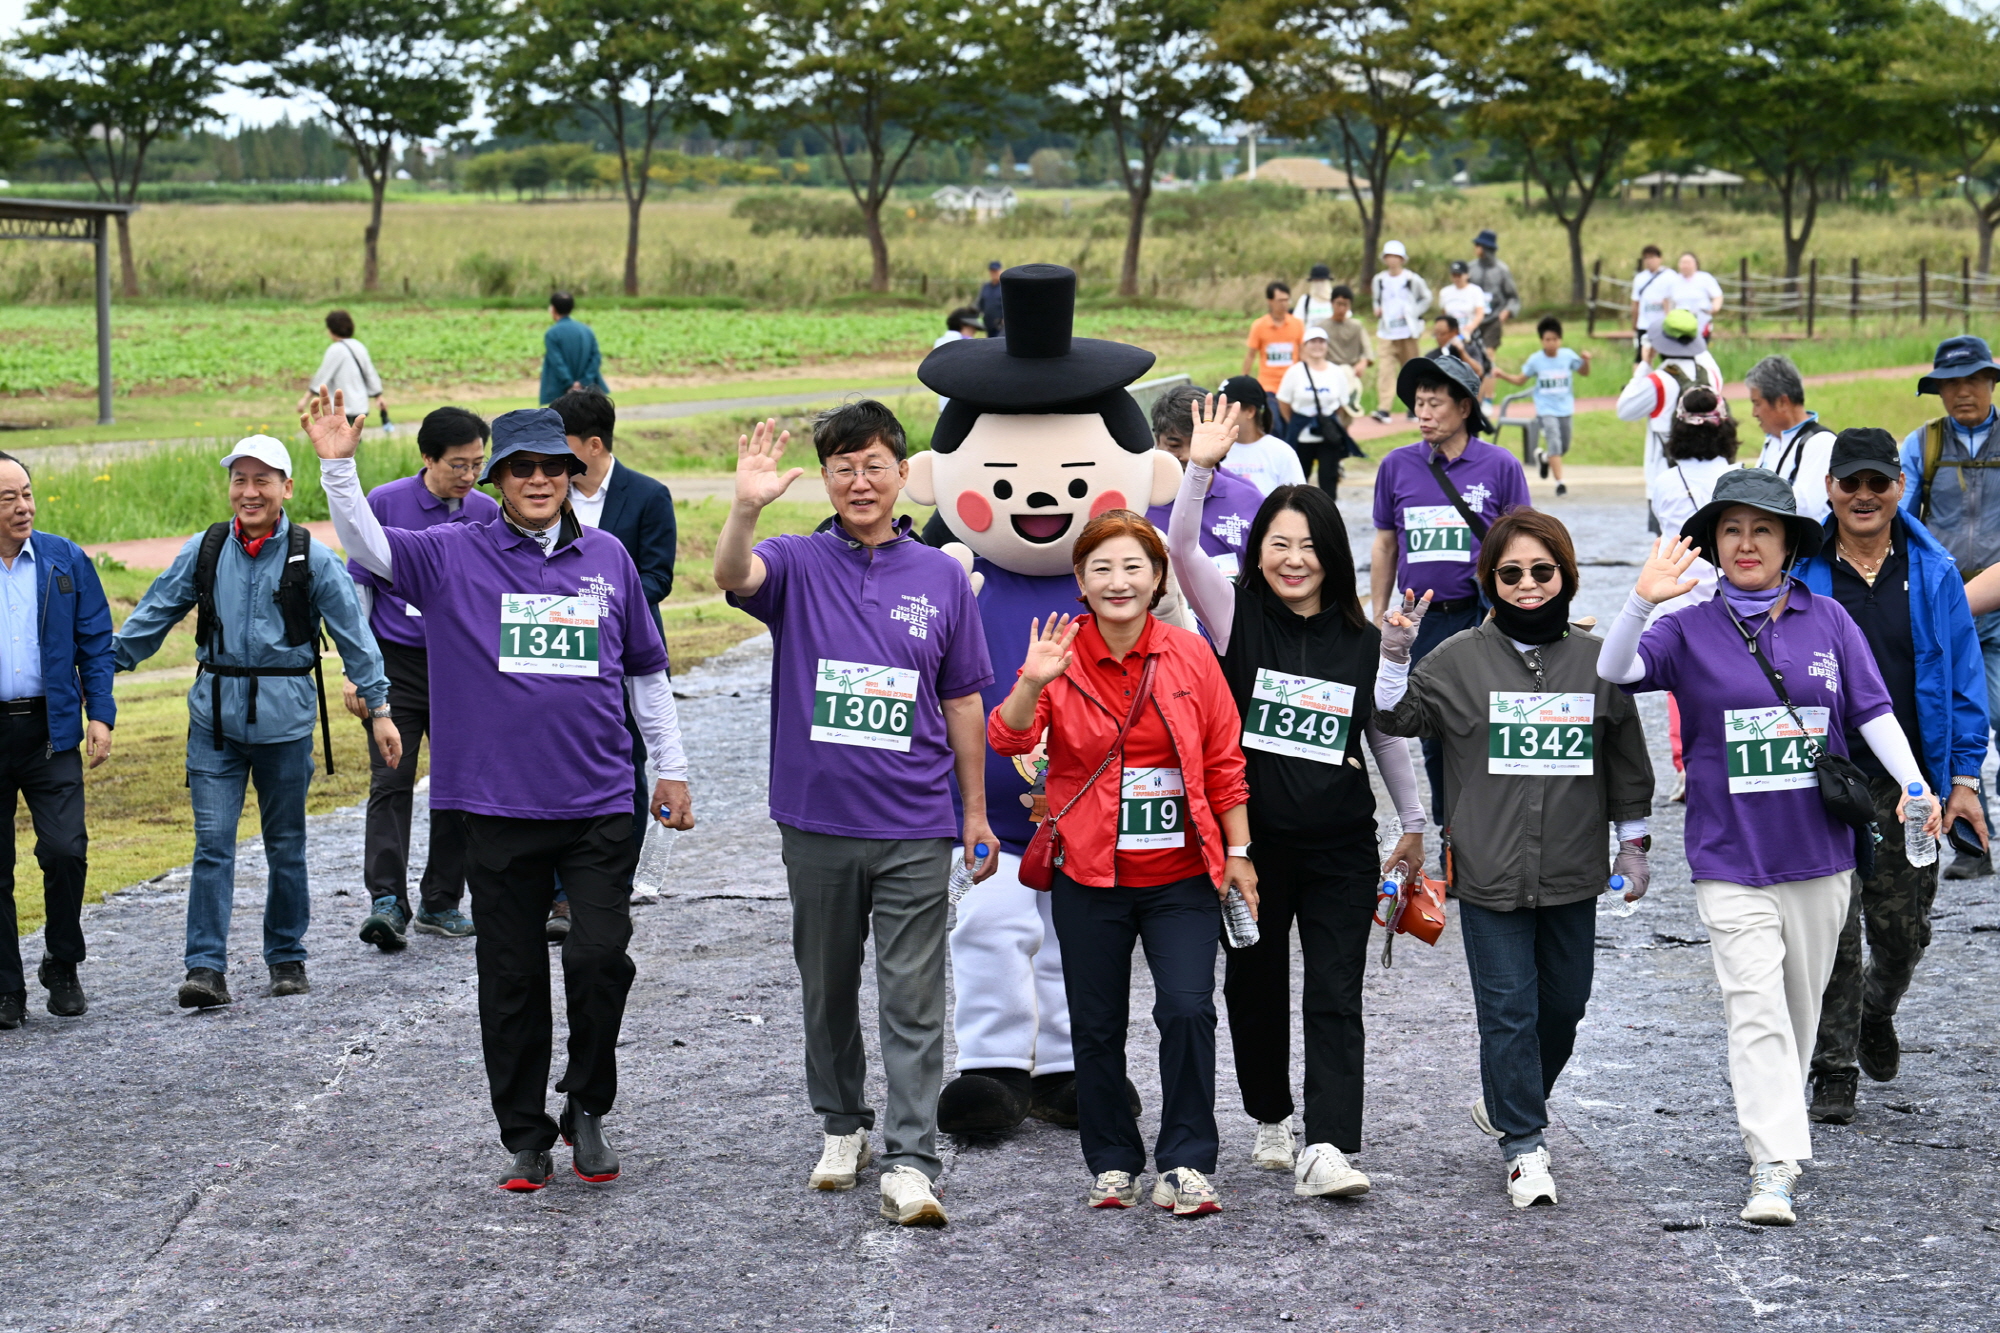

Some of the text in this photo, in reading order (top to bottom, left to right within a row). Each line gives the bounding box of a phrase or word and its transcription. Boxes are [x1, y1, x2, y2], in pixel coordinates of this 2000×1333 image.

[1410, 528, 1463, 551] 0711
[890, 608, 928, 629] 대부포도
[910, 602, 928, 617] 안산
[509, 626, 585, 657] 1341
[908, 625, 928, 640] 축제
[825, 695, 908, 732] 1306
[1258, 703, 1340, 745] 1349
[1498, 726, 1584, 757] 1342
[1736, 738, 1819, 774] 1143
